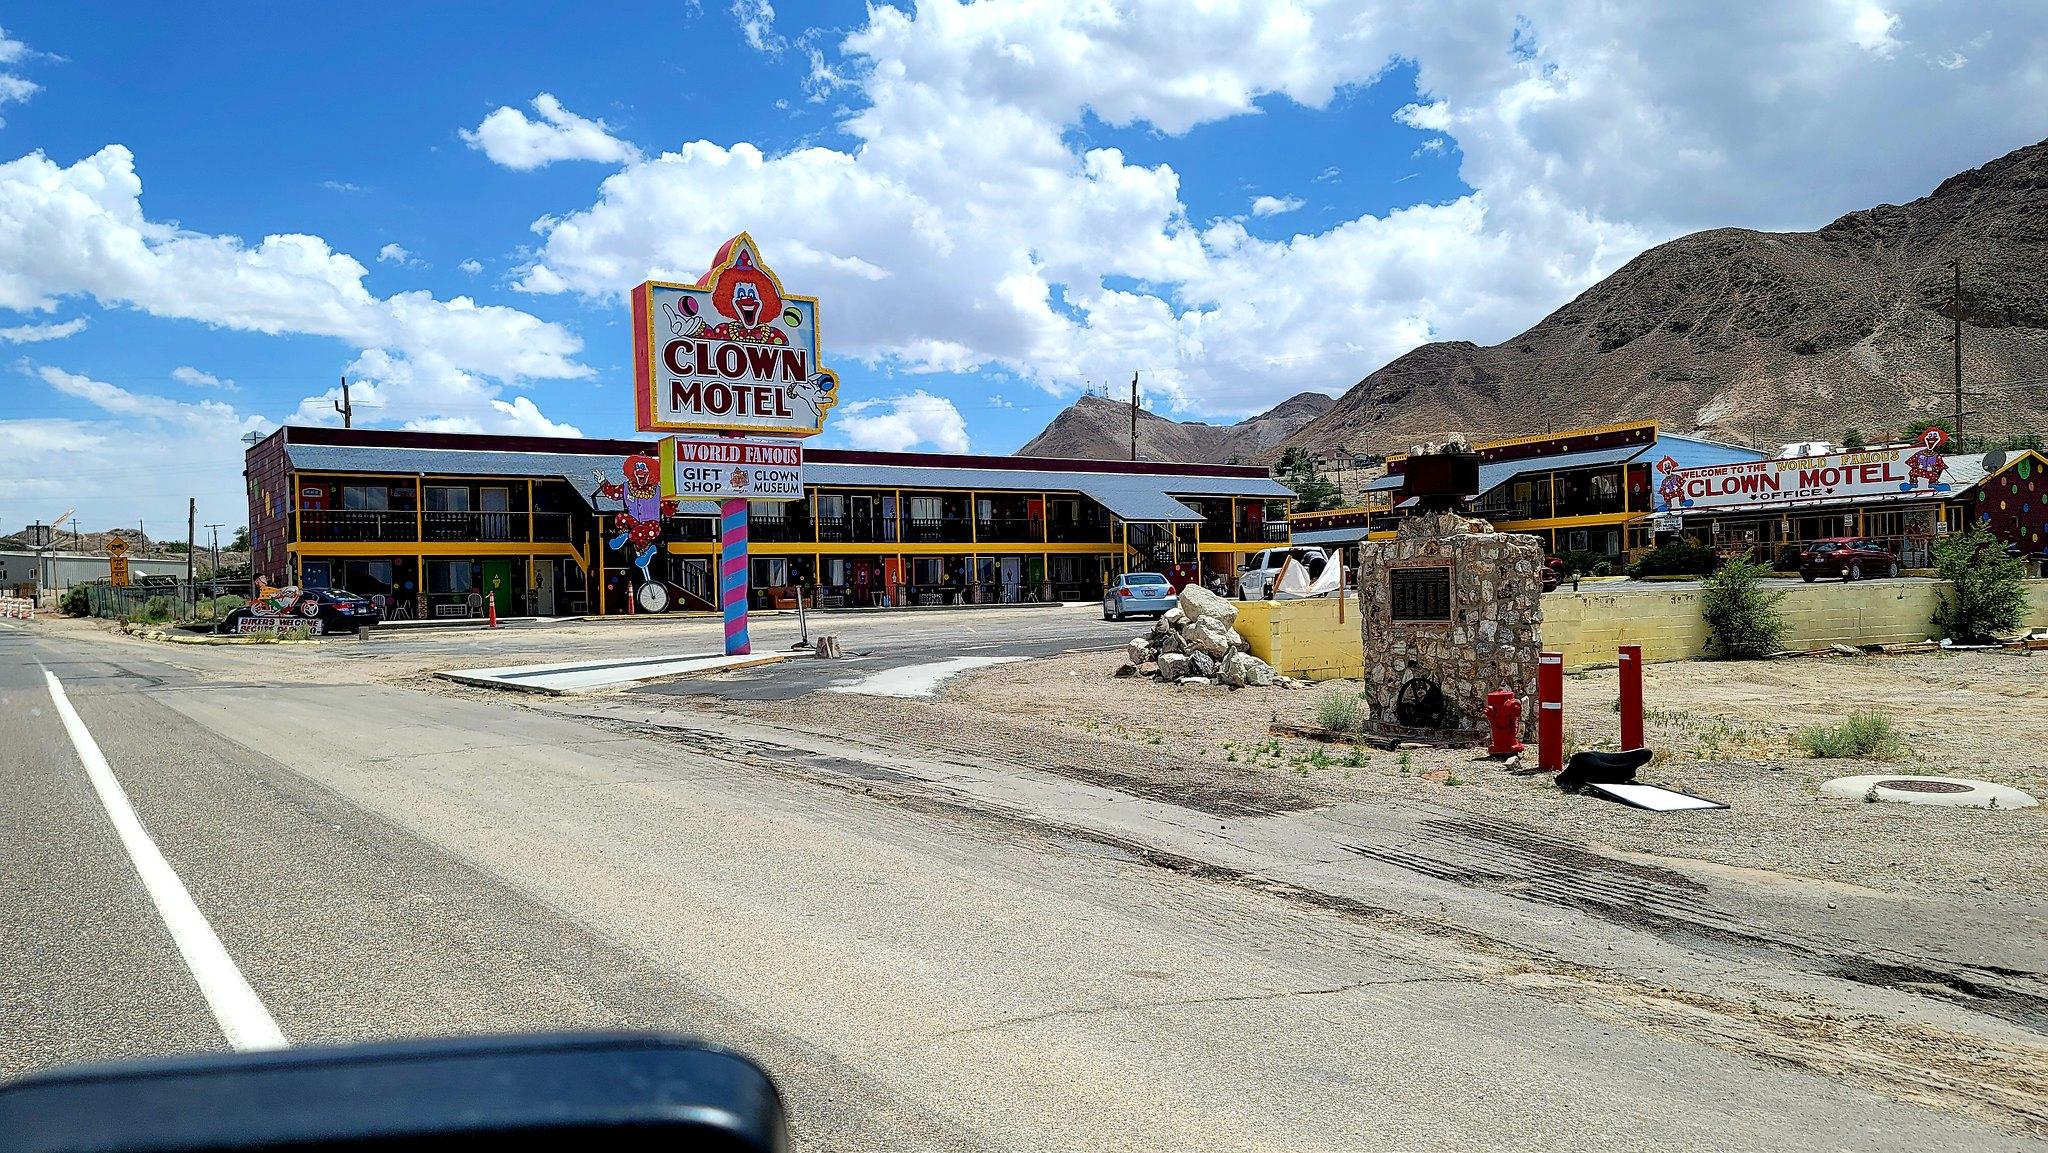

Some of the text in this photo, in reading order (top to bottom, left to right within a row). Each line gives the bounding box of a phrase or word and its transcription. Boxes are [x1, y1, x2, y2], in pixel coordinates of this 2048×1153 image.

[663, 339, 808, 382] CLOWN
[671, 380, 793, 417] MOTEL
[682, 443, 797, 465] WORLD FAMOUS
[1681, 450, 1900, 479] WELCOME TO THE WORLD FAMOUS
[683, 467, 722, 480] GIFT
[754, 470, 799, 482] CLOWN
[1687, 462, 1905, 498] CLOWN MOTEL
[683, 481, 721, 493] SHOP
[753, 482, 799, 494] MUSEUM
[1760, 488, 1822, 500] OFFICE
[240, 618, 275, 626] BIKERS
